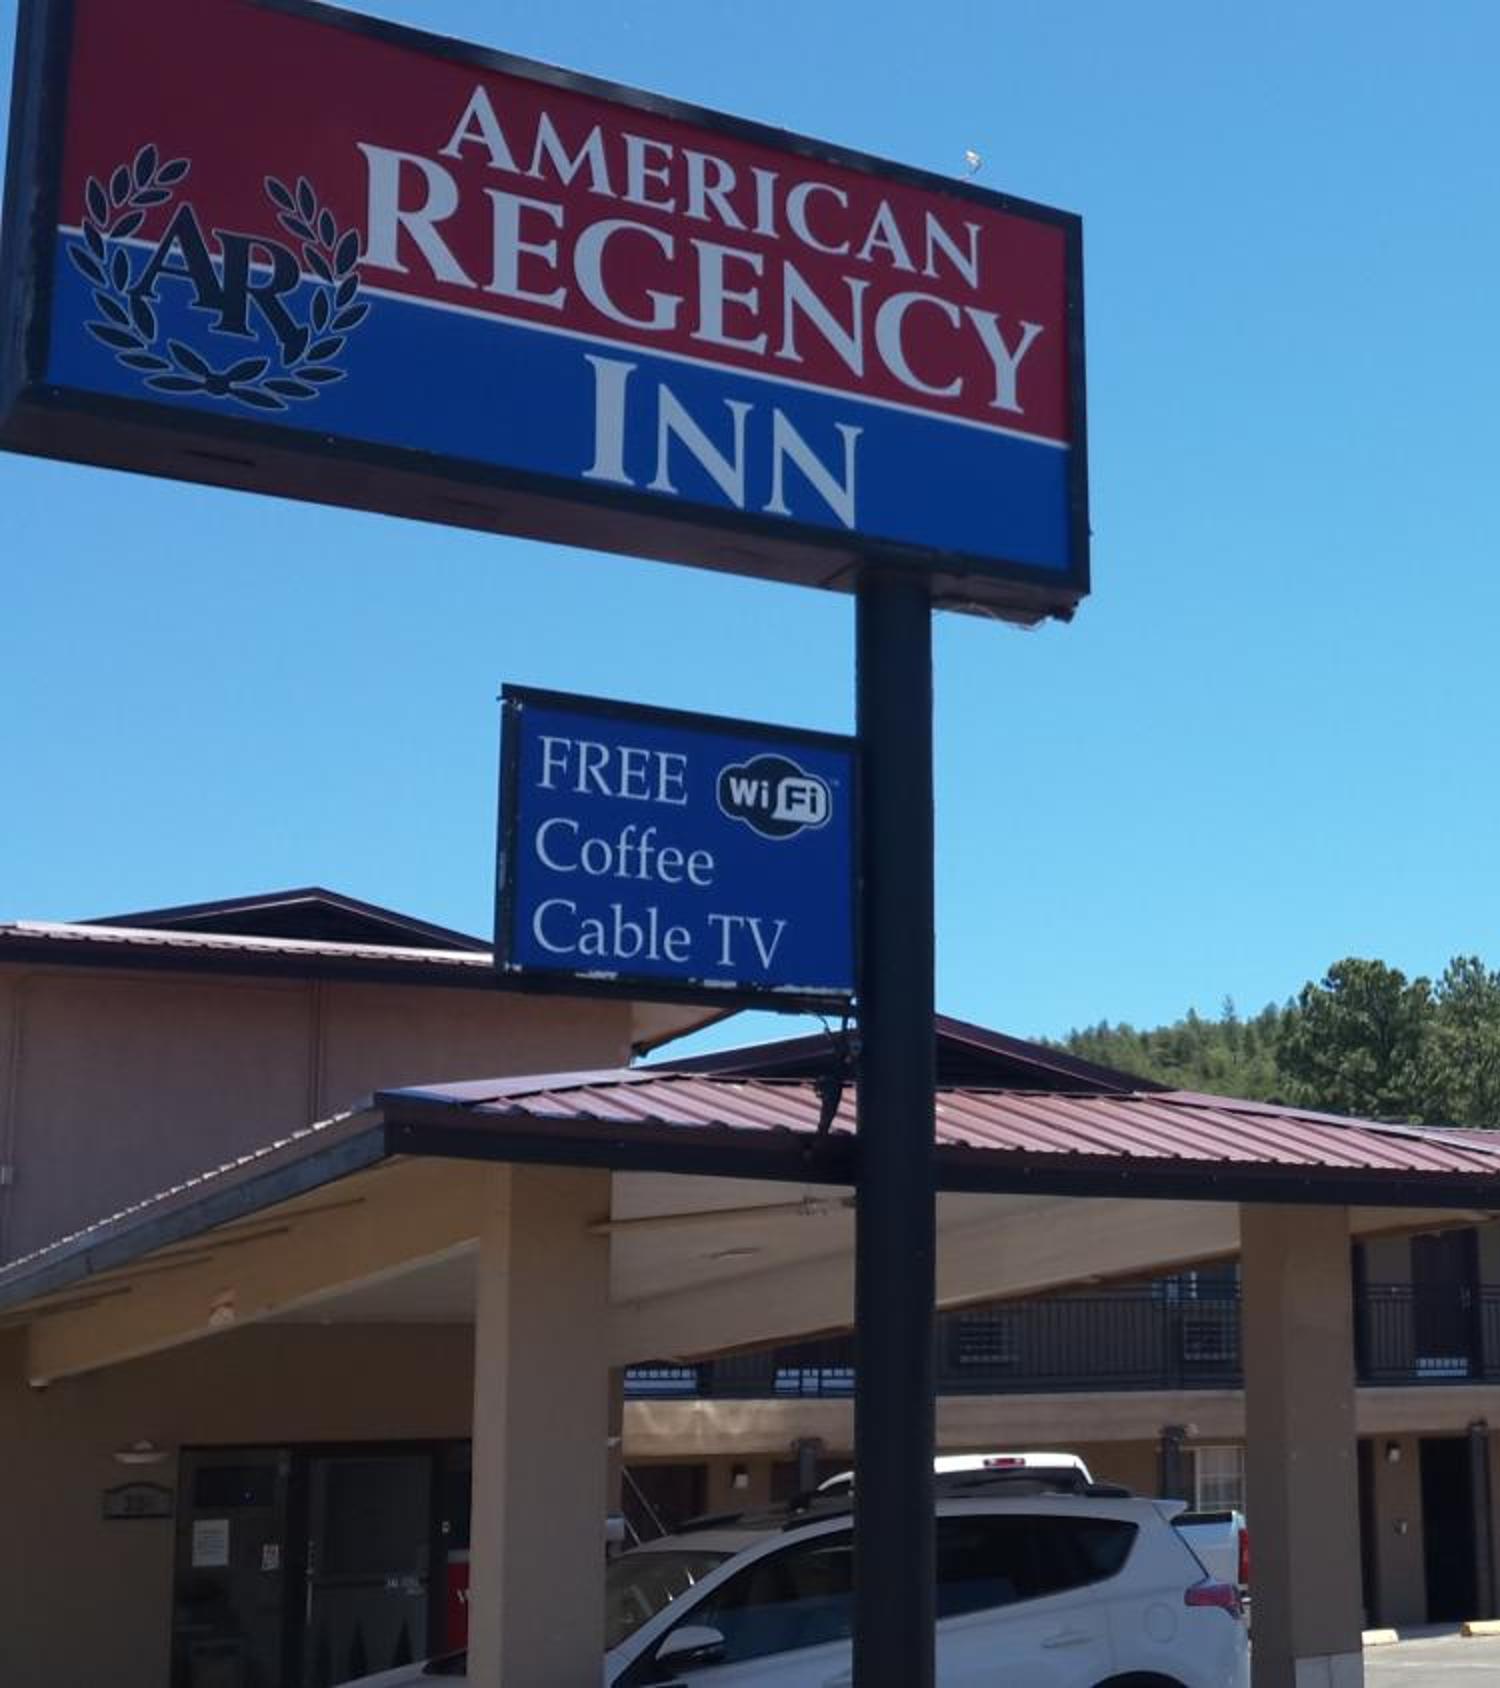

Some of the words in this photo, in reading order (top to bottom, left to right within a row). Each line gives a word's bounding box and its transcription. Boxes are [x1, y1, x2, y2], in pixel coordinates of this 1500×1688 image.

[439, 86, 980, 288] AMERICAN
[356, 142, 1043, 414] REGENCY
[581, 353, 864, 530] INN
[537, 736, 688, 806] FREE
[535, 817, 714, 886] Coffee
[532, 898, 691, 963] Cable
[708, 914, 787, 969] TV
